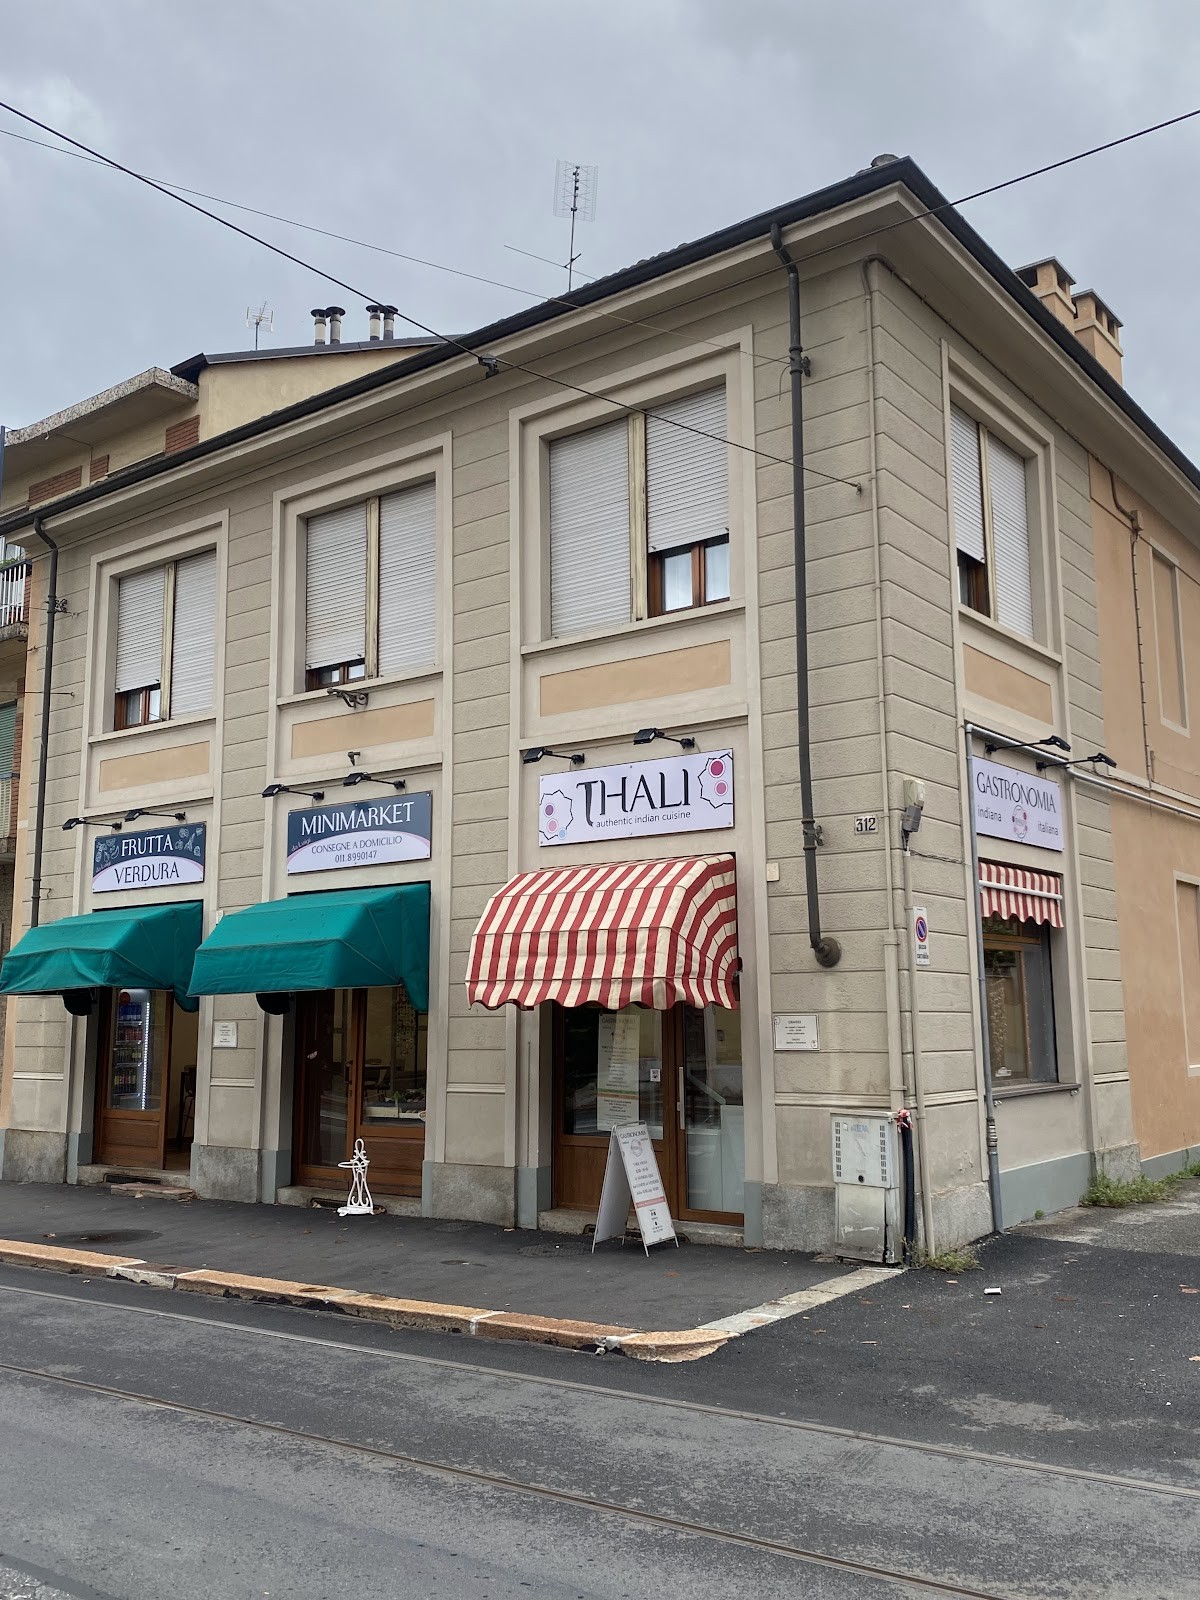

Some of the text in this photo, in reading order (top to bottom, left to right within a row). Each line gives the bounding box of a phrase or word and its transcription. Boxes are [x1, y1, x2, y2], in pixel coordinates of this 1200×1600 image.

[576, 768, 690, 827] THALI
[976, 771, 1057, 814] GASTRONOMIA
[301, 801, 415, 836] MINIMARKET
[595, 811, 691, 828] authentic indian cuisine
[977, 805, 1002, 822] indiana
[856, 817, 876, 832] 312
[1037, 822, 1059, 836] italiana
[121, 833, 173, 857] FRUTTA
[311, 835, 403, 854] CONSEGNE A DOMICILIO
[334, 850, 378, 863] 011.8990147
[114, 861, 180, 884] VERDURA
